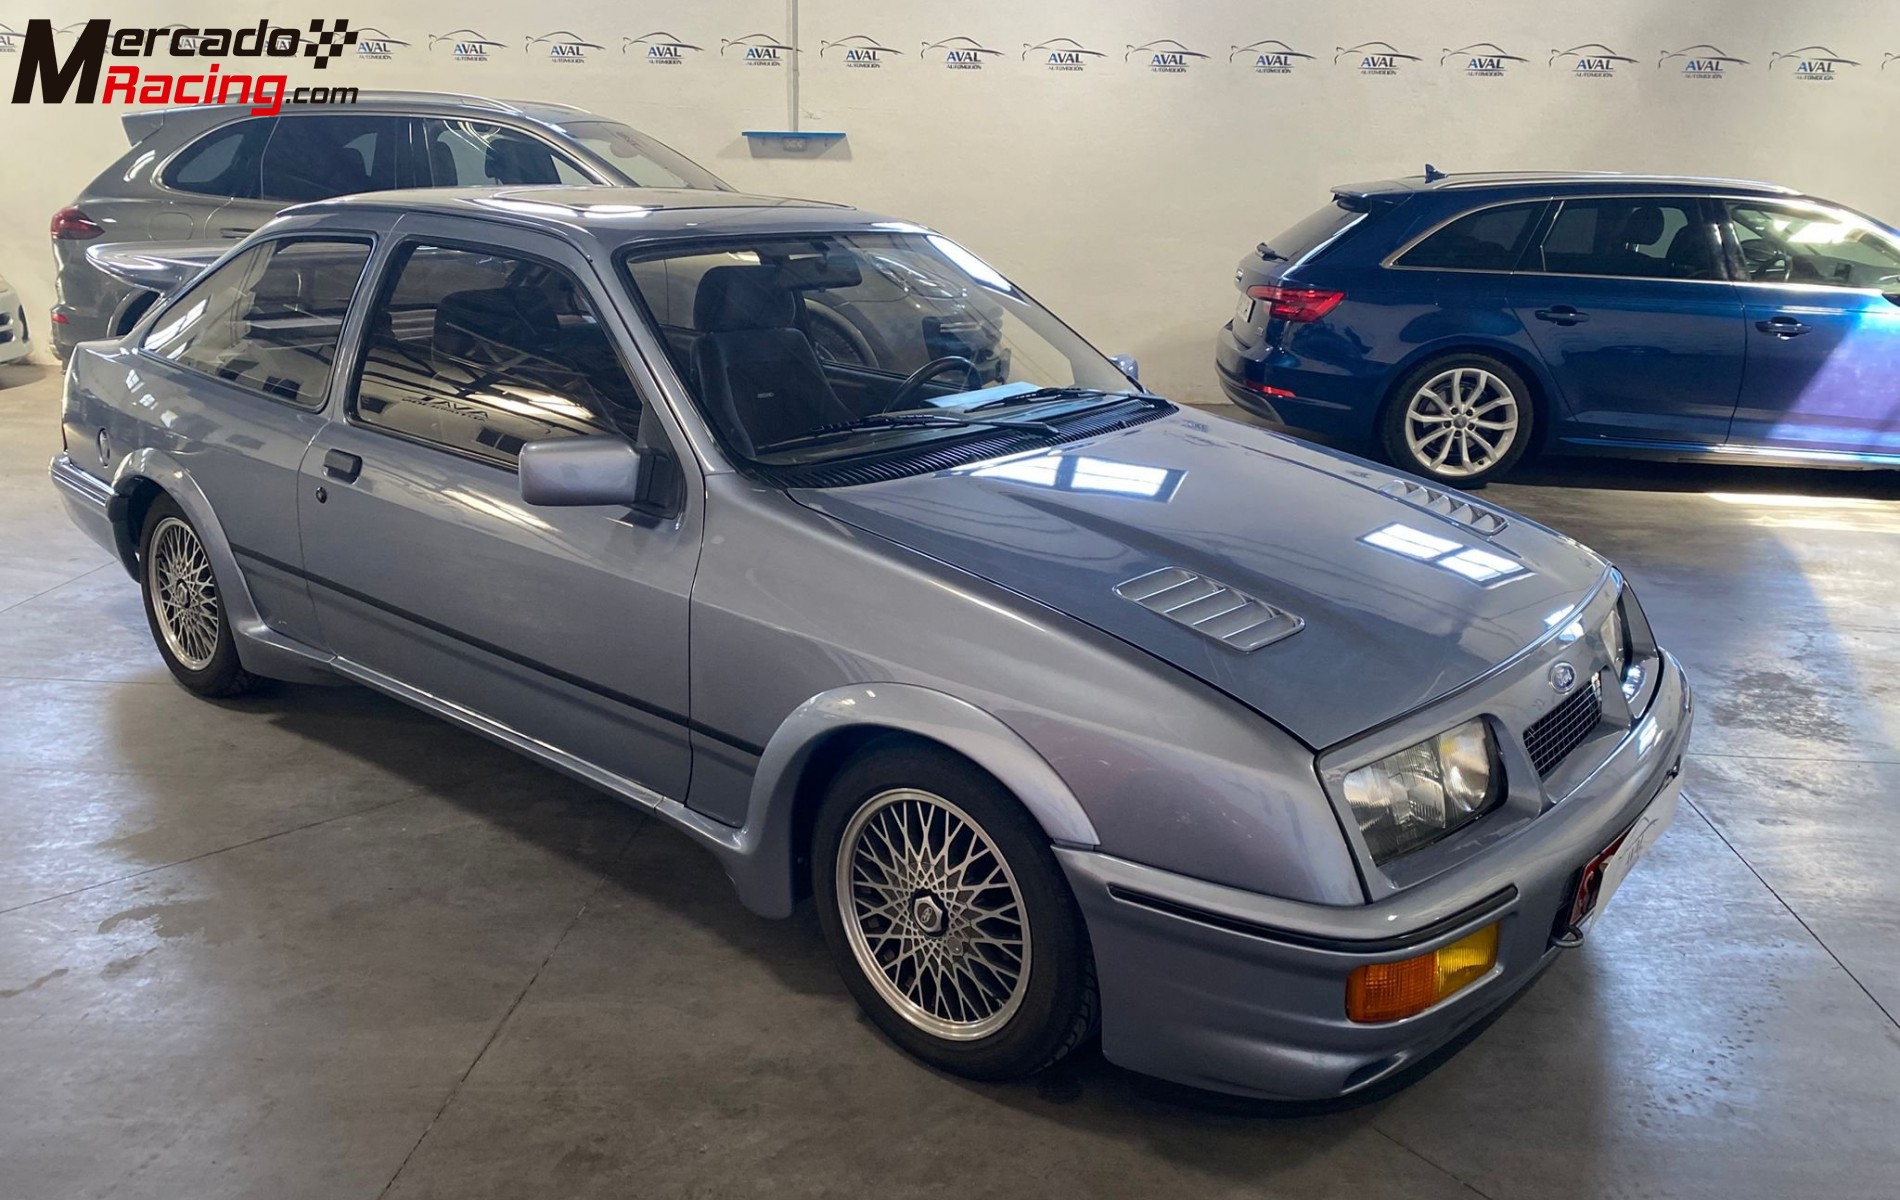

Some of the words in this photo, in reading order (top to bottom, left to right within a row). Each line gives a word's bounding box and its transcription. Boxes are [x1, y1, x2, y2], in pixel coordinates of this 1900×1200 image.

[357, 42, 391, 53] AVAL
[453, 44, 487, 55] AVAL
[550, 46, 584, 56] AVAL
[647, 47, 682, 57] AVAL
[746, 48, 780, 59] AVAL
[846, 50, 880, 61] AVAL
[946, 51, 981, 62] AVAL
[1048, 52, 1083, 64] AVAL
[1151, 54, 1187, 65] AVAL
[1255, 55, 1292, 66] AVAL
[1360, 57, 1397, 68] AVAL
[1467, 58, 1504, 69] AVAL
[1576, 59, 1613, 70] AVAL
[1685, 60, 1723, 71] AVAL
[1796, 62, 1834, 73] AVAL
